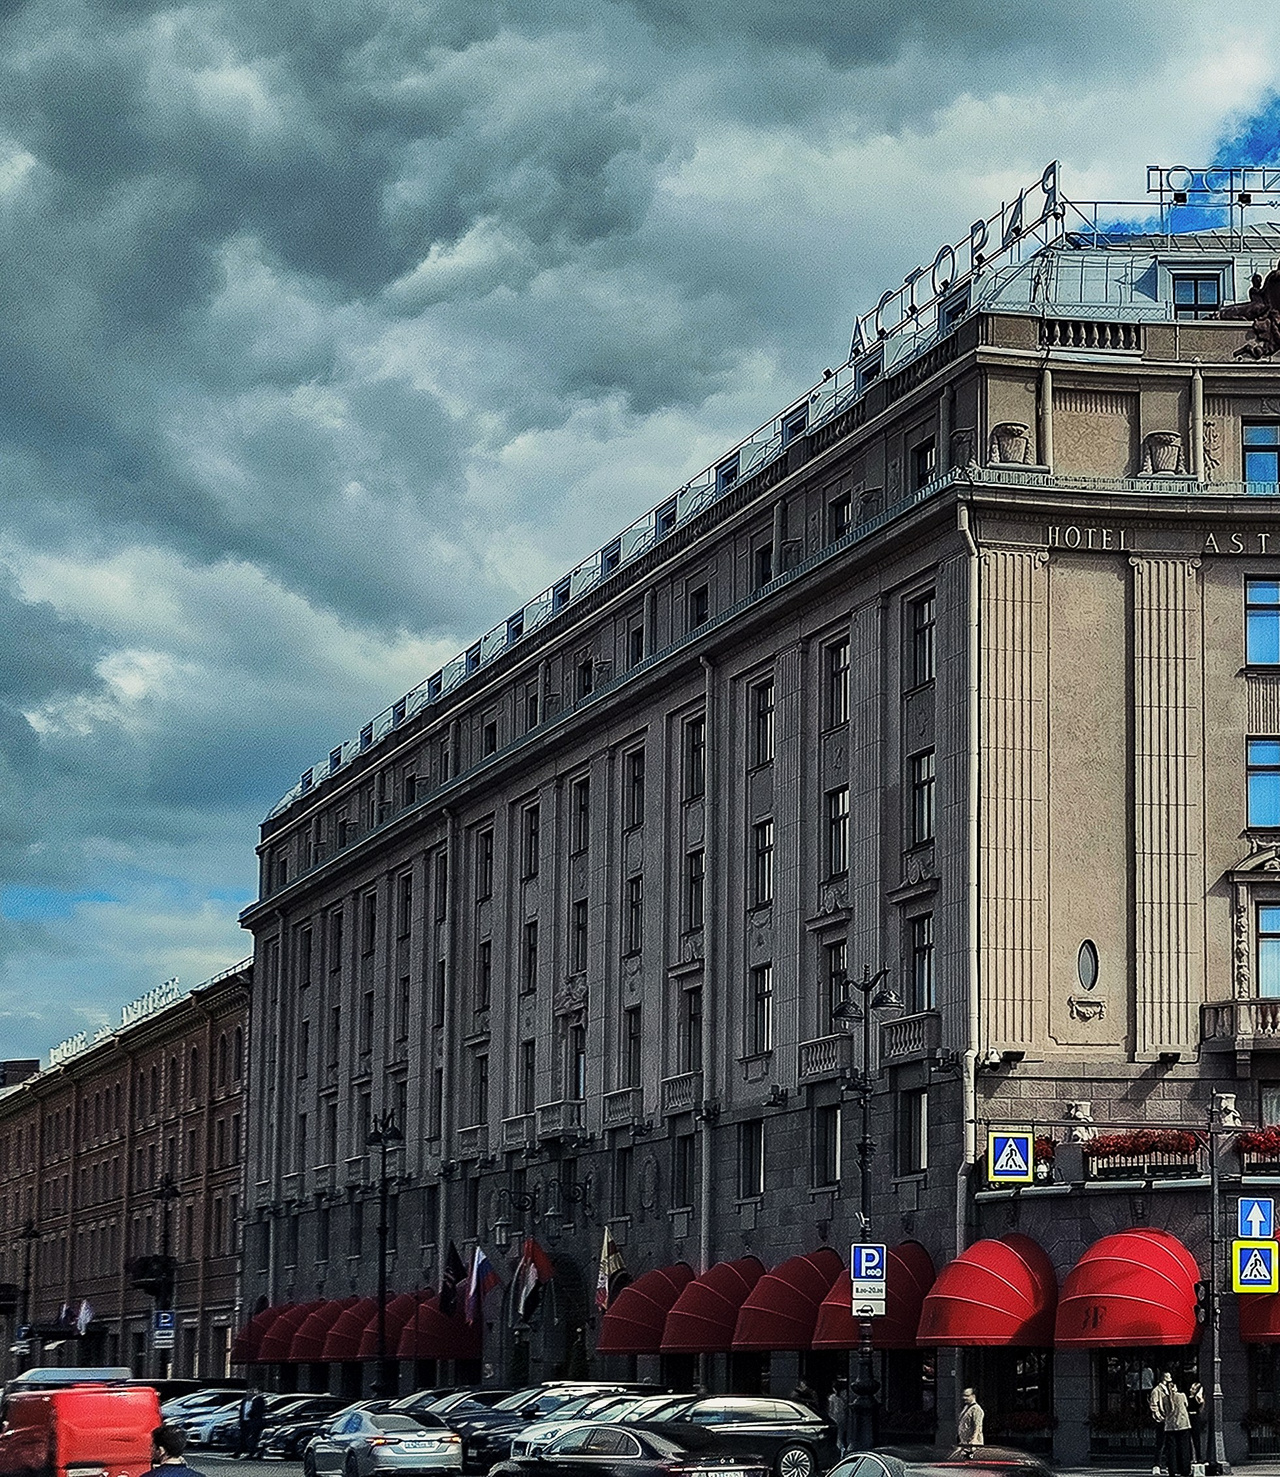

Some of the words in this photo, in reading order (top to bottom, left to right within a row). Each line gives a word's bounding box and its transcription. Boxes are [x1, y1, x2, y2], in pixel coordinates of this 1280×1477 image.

[849, 159, 1061, 360] АСТОРИЯ
[1048, 525, 1129, 551] HOTEL
[861, 1248, 880, 1277] P
